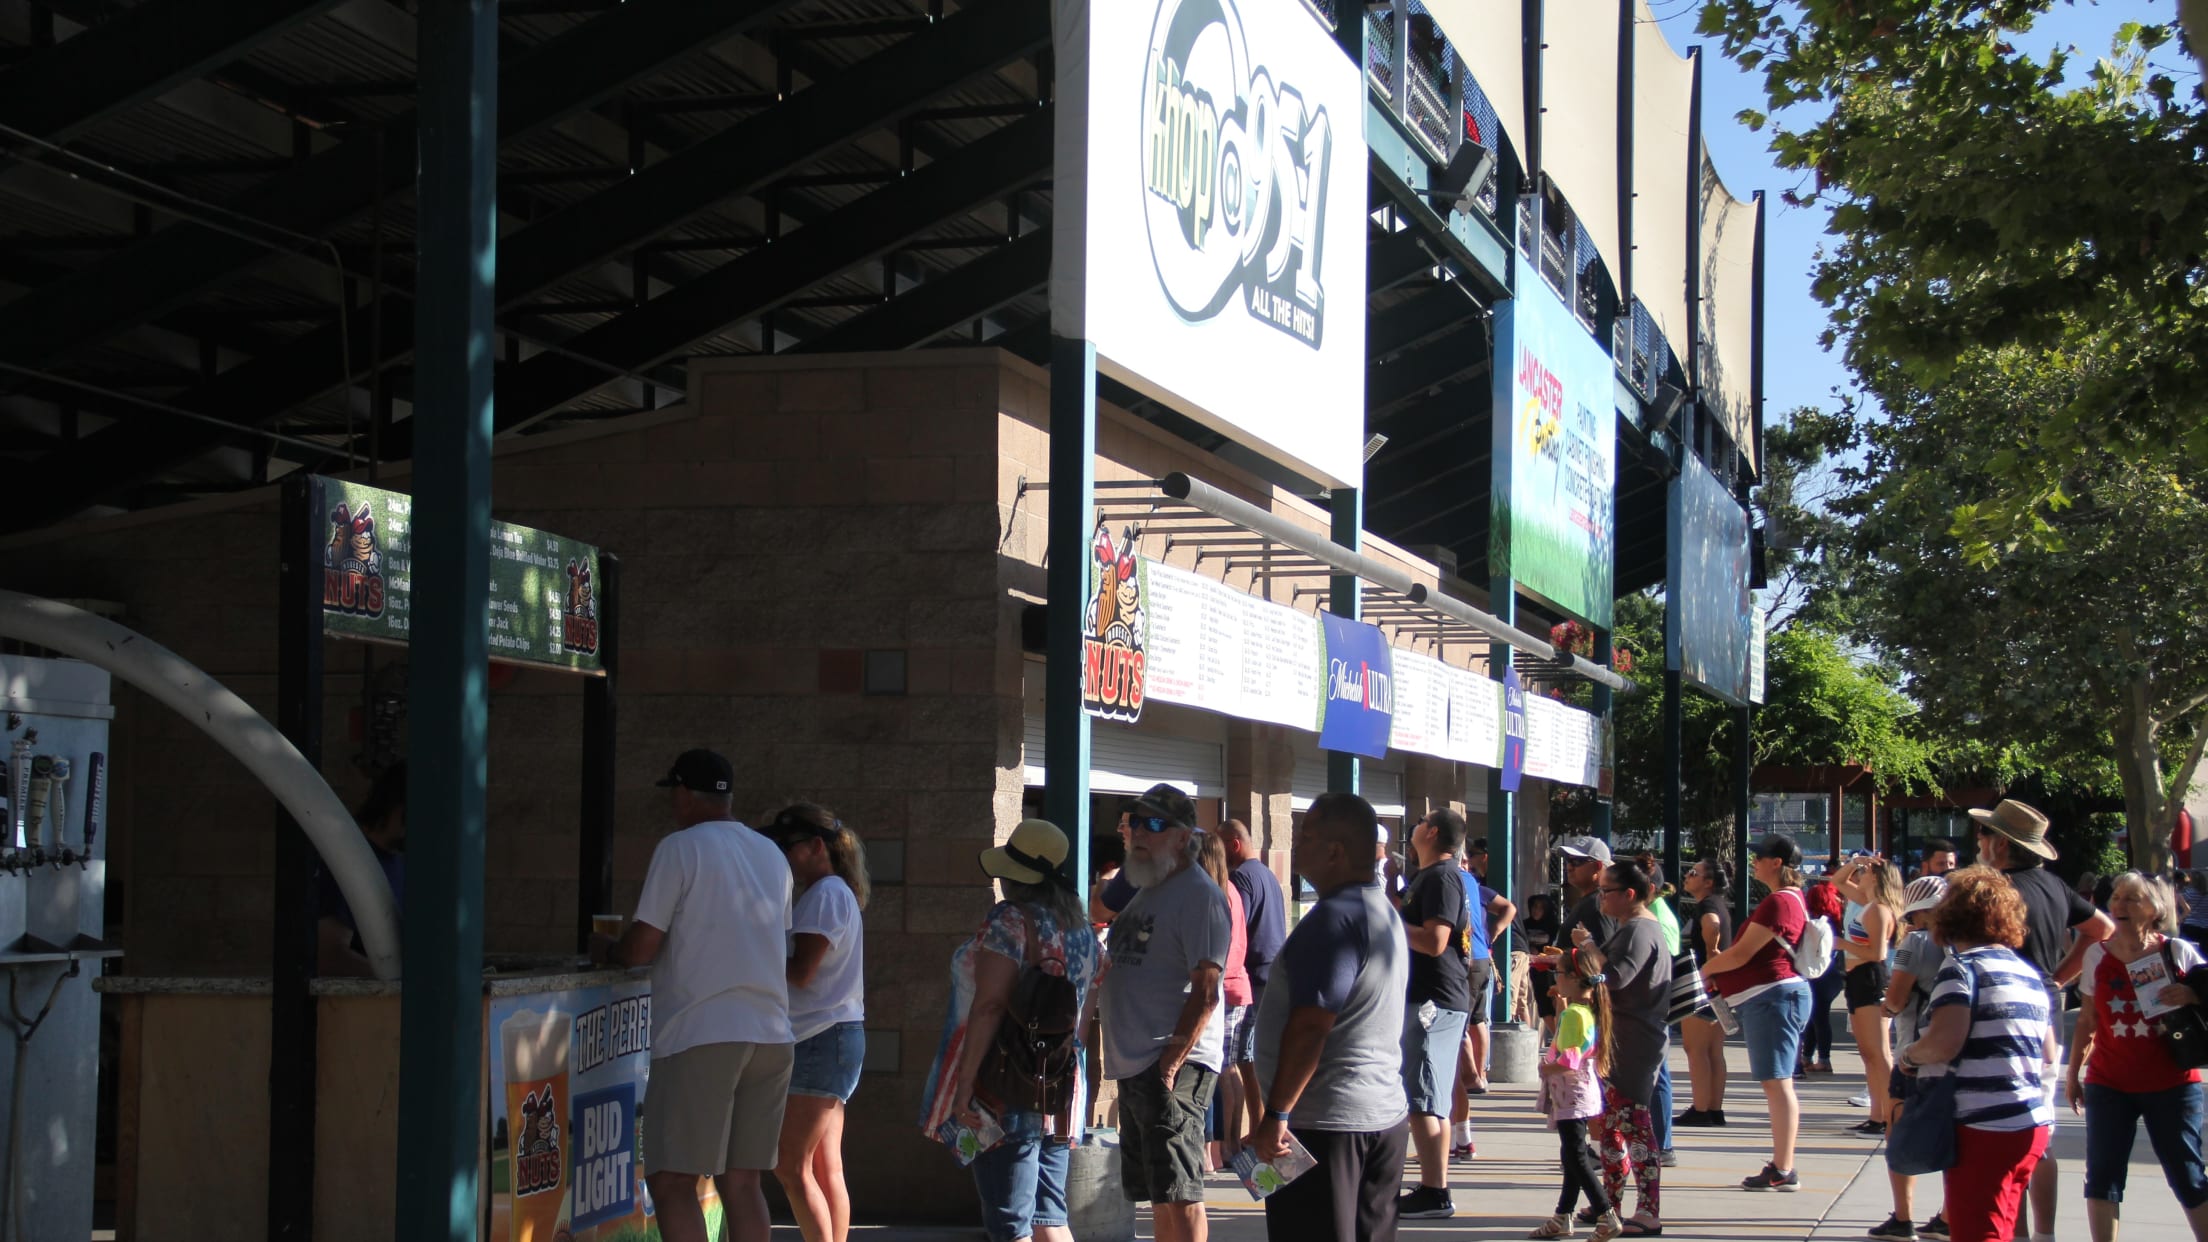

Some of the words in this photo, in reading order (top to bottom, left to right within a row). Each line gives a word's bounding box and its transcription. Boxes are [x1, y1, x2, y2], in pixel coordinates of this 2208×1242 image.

[1251, 285, 1271, 319] ALL
[1272, 294, 1292, 329] THE
[1292, 304, 1316, 342] HITS!
[1518, 338, 1564, 422] LANCASTER
[324, 569, 384, 613] NUTS
[564, 613, 597, 650] NUTS
[1084, 639, 1144, 710] NUTS
[1328, 657, 1364, 704] Michelob
[1367, 668, 1393, 716] ULTRA
[1505, 710, 1526, 740] ULTRA
[576, 1005, 607, 1075] THE
[583, 1100, 623, 1160] BUD
[517, 1149, 561, 1191] NUTS
[574, 1150, 631, 1217] LIGHT
